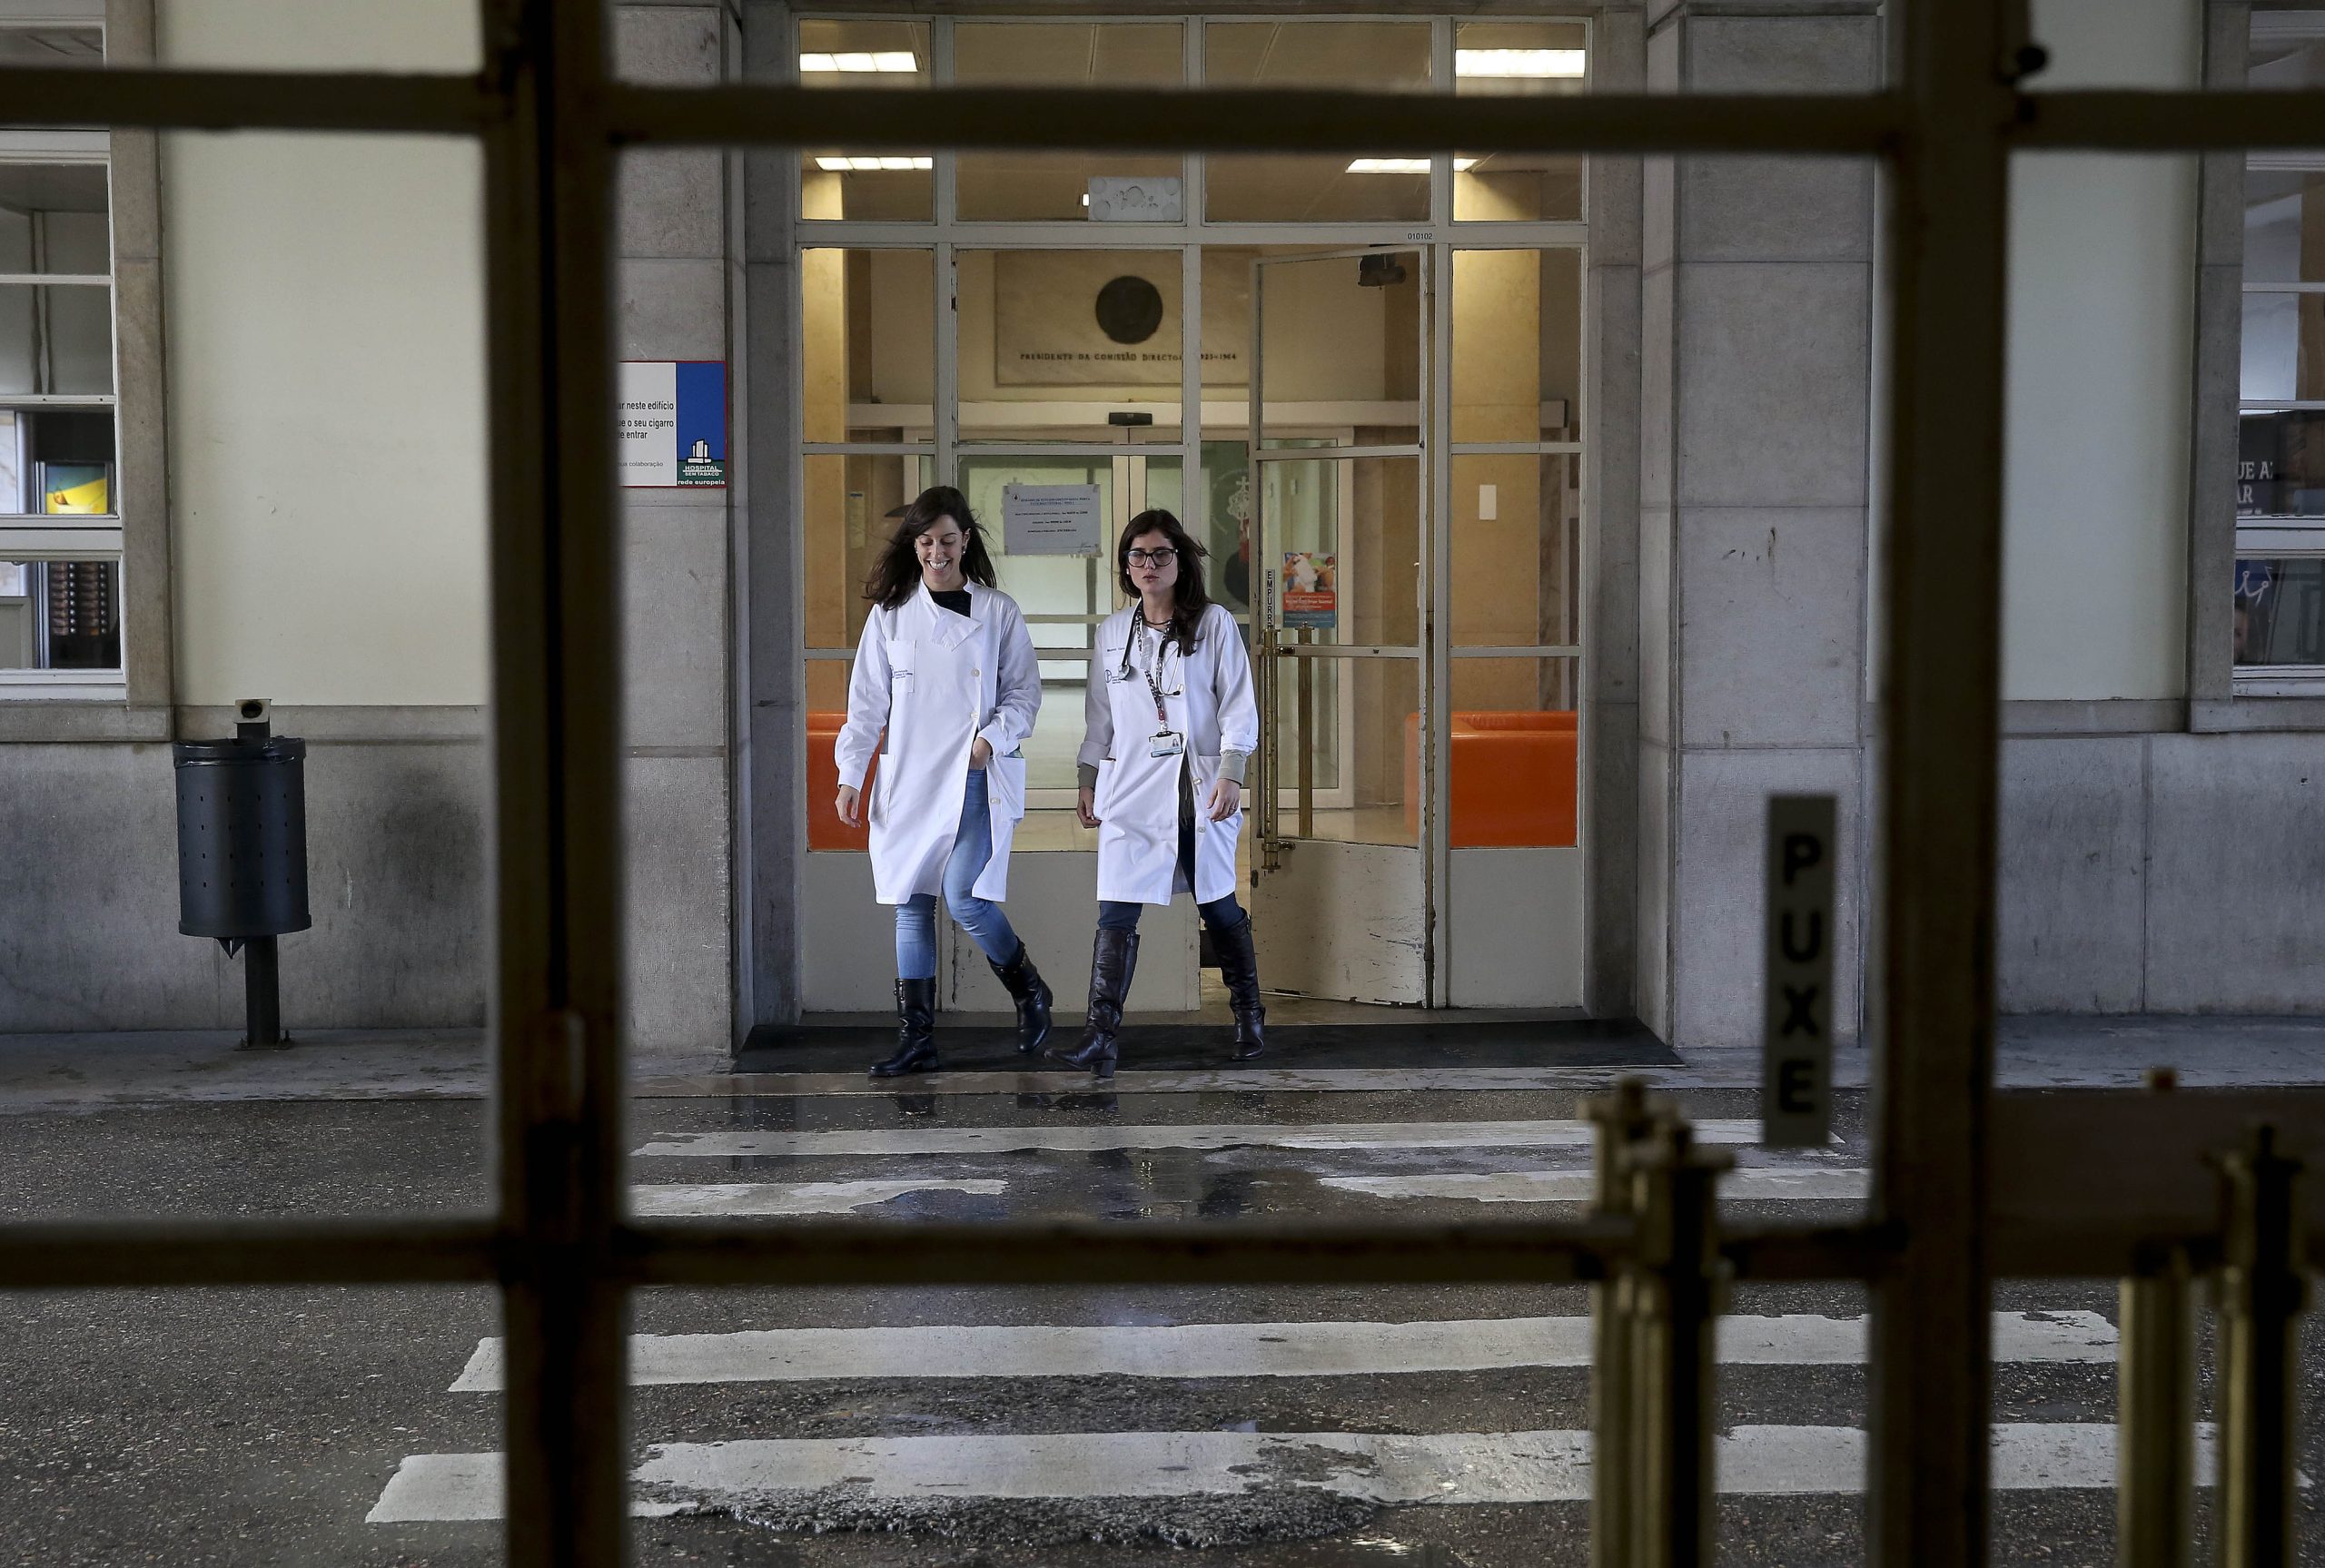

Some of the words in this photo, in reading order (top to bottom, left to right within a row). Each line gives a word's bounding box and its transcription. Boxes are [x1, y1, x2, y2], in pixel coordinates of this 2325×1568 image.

[1020, 352, 1073, 360] PRESIDENTE
[1094, 351, 1137, 361] COMISSÃO
[1142, 353, 1182, 361] DIRECTO
[626, 401, 646, 410] neste
[648, 419, 674, 429] cigarro
[626, 430, 648, 439] entrar
[1780, 833, 1822, 1113] PUXE
